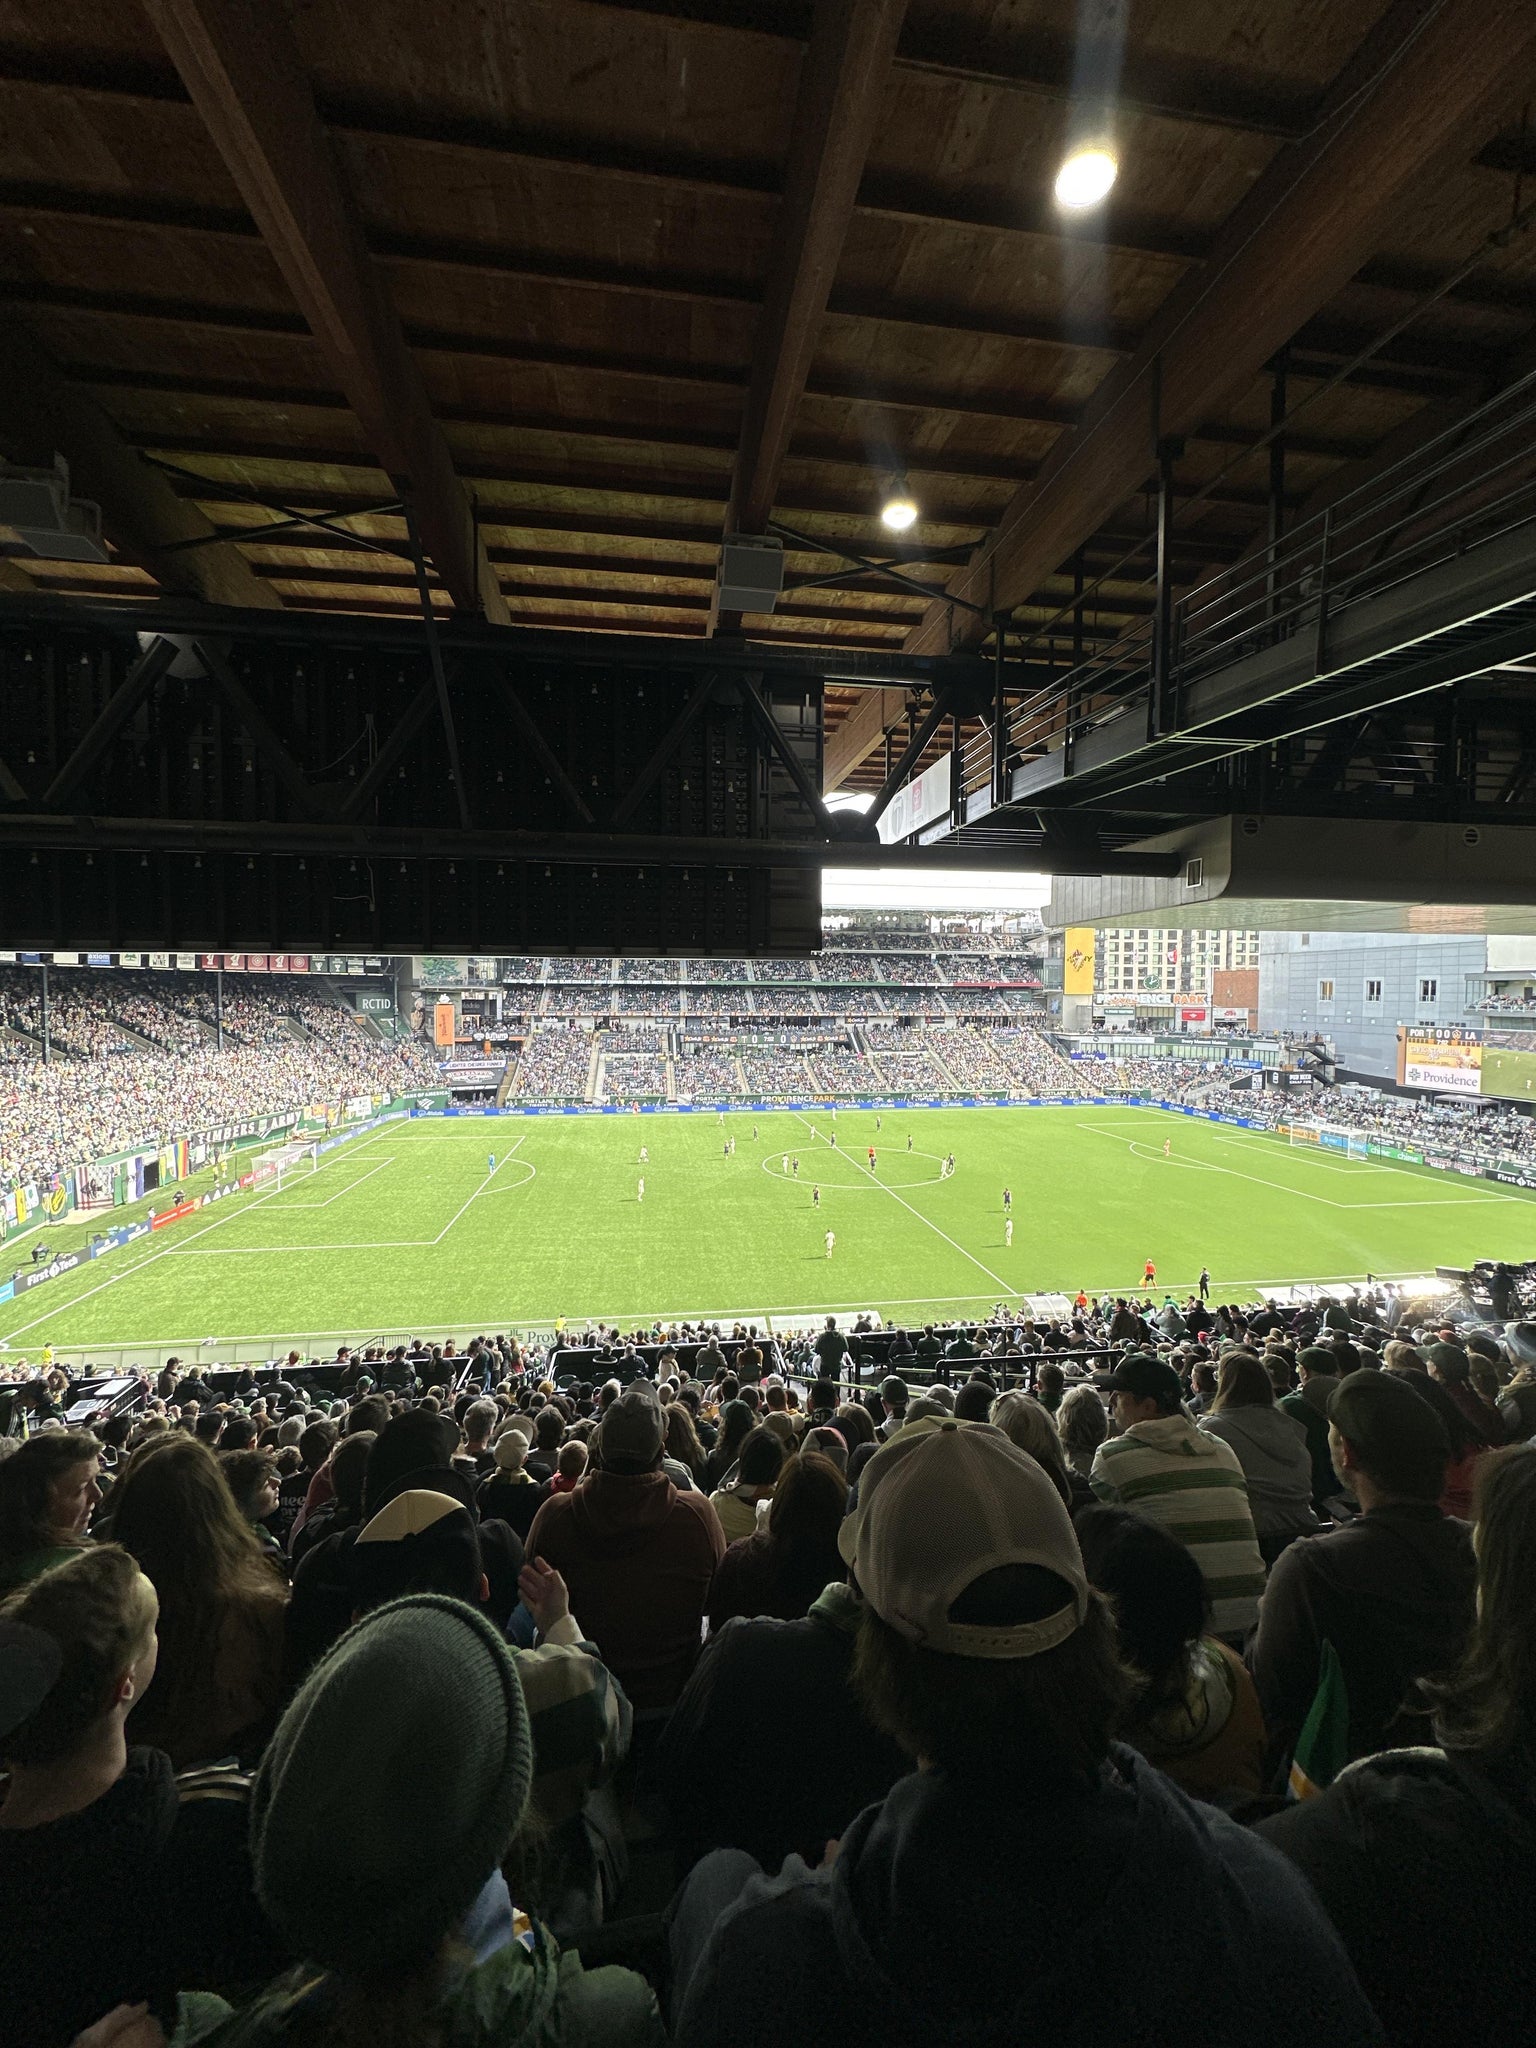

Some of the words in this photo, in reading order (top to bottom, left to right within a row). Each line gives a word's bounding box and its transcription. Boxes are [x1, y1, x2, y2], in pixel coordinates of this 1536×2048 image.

[362, 998, 391, 1010] RCTID
[1173, 993, 1207, 1004] PARK
[752, 1034, 758, 1044] 0
[780, 1034, 787, 1044] 0
[1410, 1028, 1424, 1037] POR
[1436, 1030, 1442, 1039] 0
[1444, 1030, 1450, 1039] 0
[1465, 1031, 1476, 1040] LA
[1423, 1071, 1478, 1087] Providence
[198, 1121, 256, 1144] TIMBERS
[270, 1111, 302, 1129] ARMY
[1397, 1152, 1419, 1164] chime
[1497, 1173, 1516, 1184] First
[27, 1268, 49, 1287] First
[58, 1255, 79, 1272] Tech
